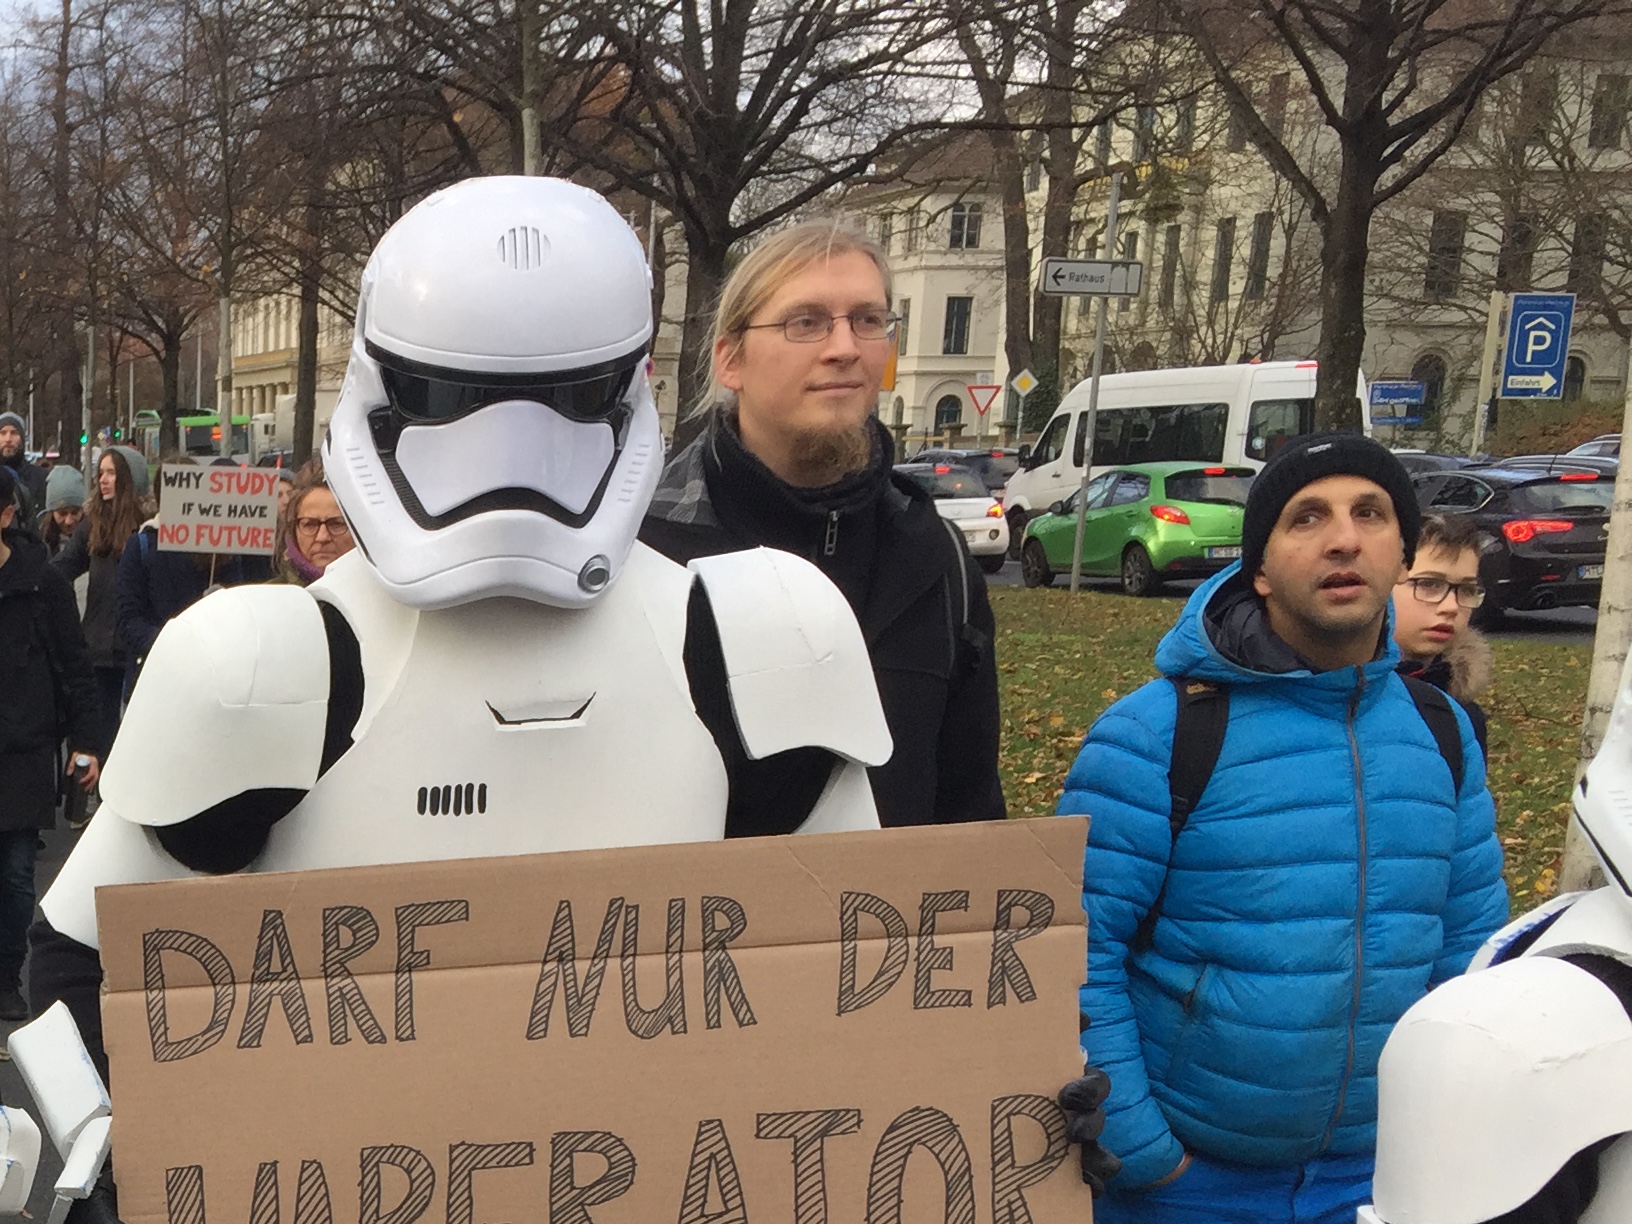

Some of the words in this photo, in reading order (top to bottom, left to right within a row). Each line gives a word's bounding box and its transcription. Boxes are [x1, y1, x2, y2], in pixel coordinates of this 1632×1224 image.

[1069, 272, 1105, 283] Rathaus
[1526, 330, 1552, 363] P
[1510, 377, 1541, 387] Einfahrt
[163, 471, 204, 489] WHY
[209, 471, 278, 496] STUDY
[181, 502, 194, 516] IF
[198, 503, 222, 518] WE
[227, 504, 268, 518] HAVE
[159, 523, 190, 545] NO
[195, 523, 274, 549] FUTURE
[142, 899, 470, 1062] DARF
[526, 896, 758, 1042] NUR
[836, 890, 1058, 1016] DER
